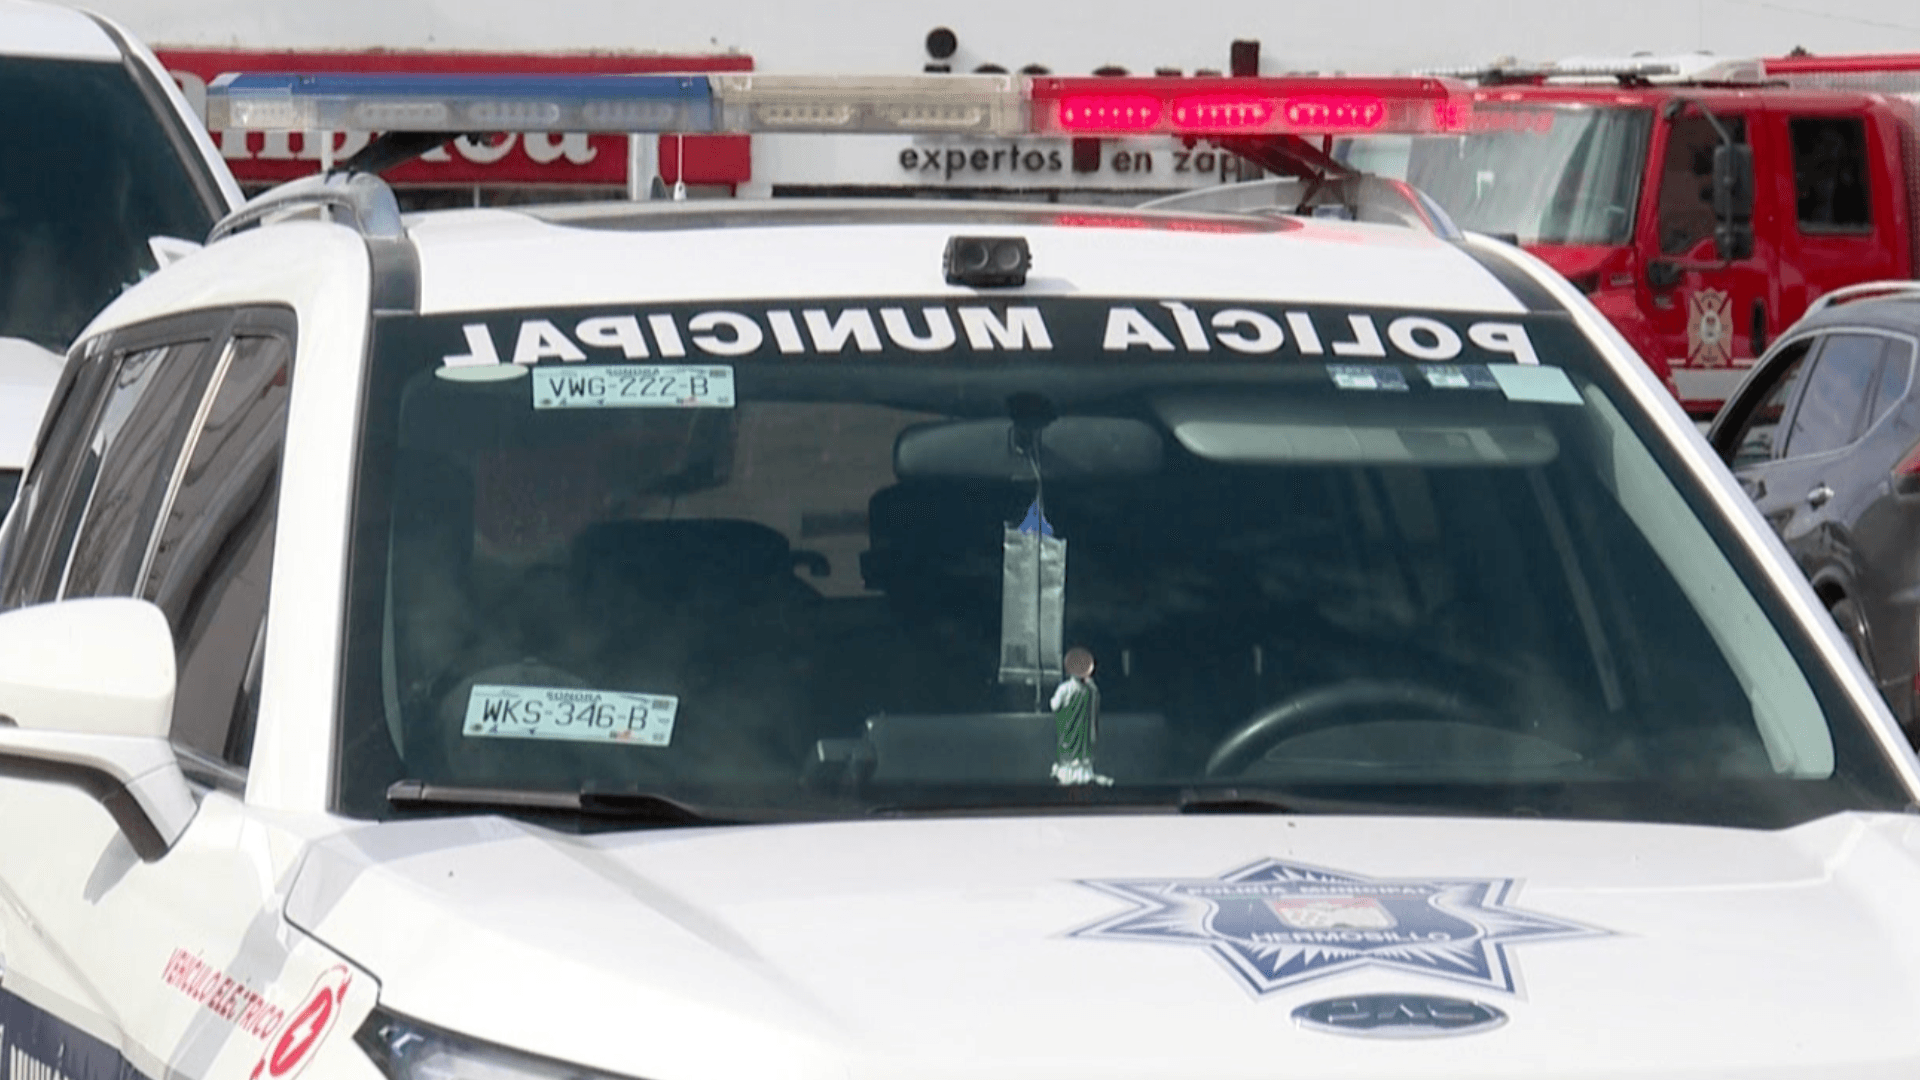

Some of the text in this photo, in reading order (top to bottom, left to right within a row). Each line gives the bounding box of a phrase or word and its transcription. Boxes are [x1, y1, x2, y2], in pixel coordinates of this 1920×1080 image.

[900, 144, 1242, 184] expertos en zap
[549, 376, 709, 398] VWG-222-B
[482, 698, 649, 731] WKS-346-B
[1250, 930, 1451, 943] HERMOSILLO
